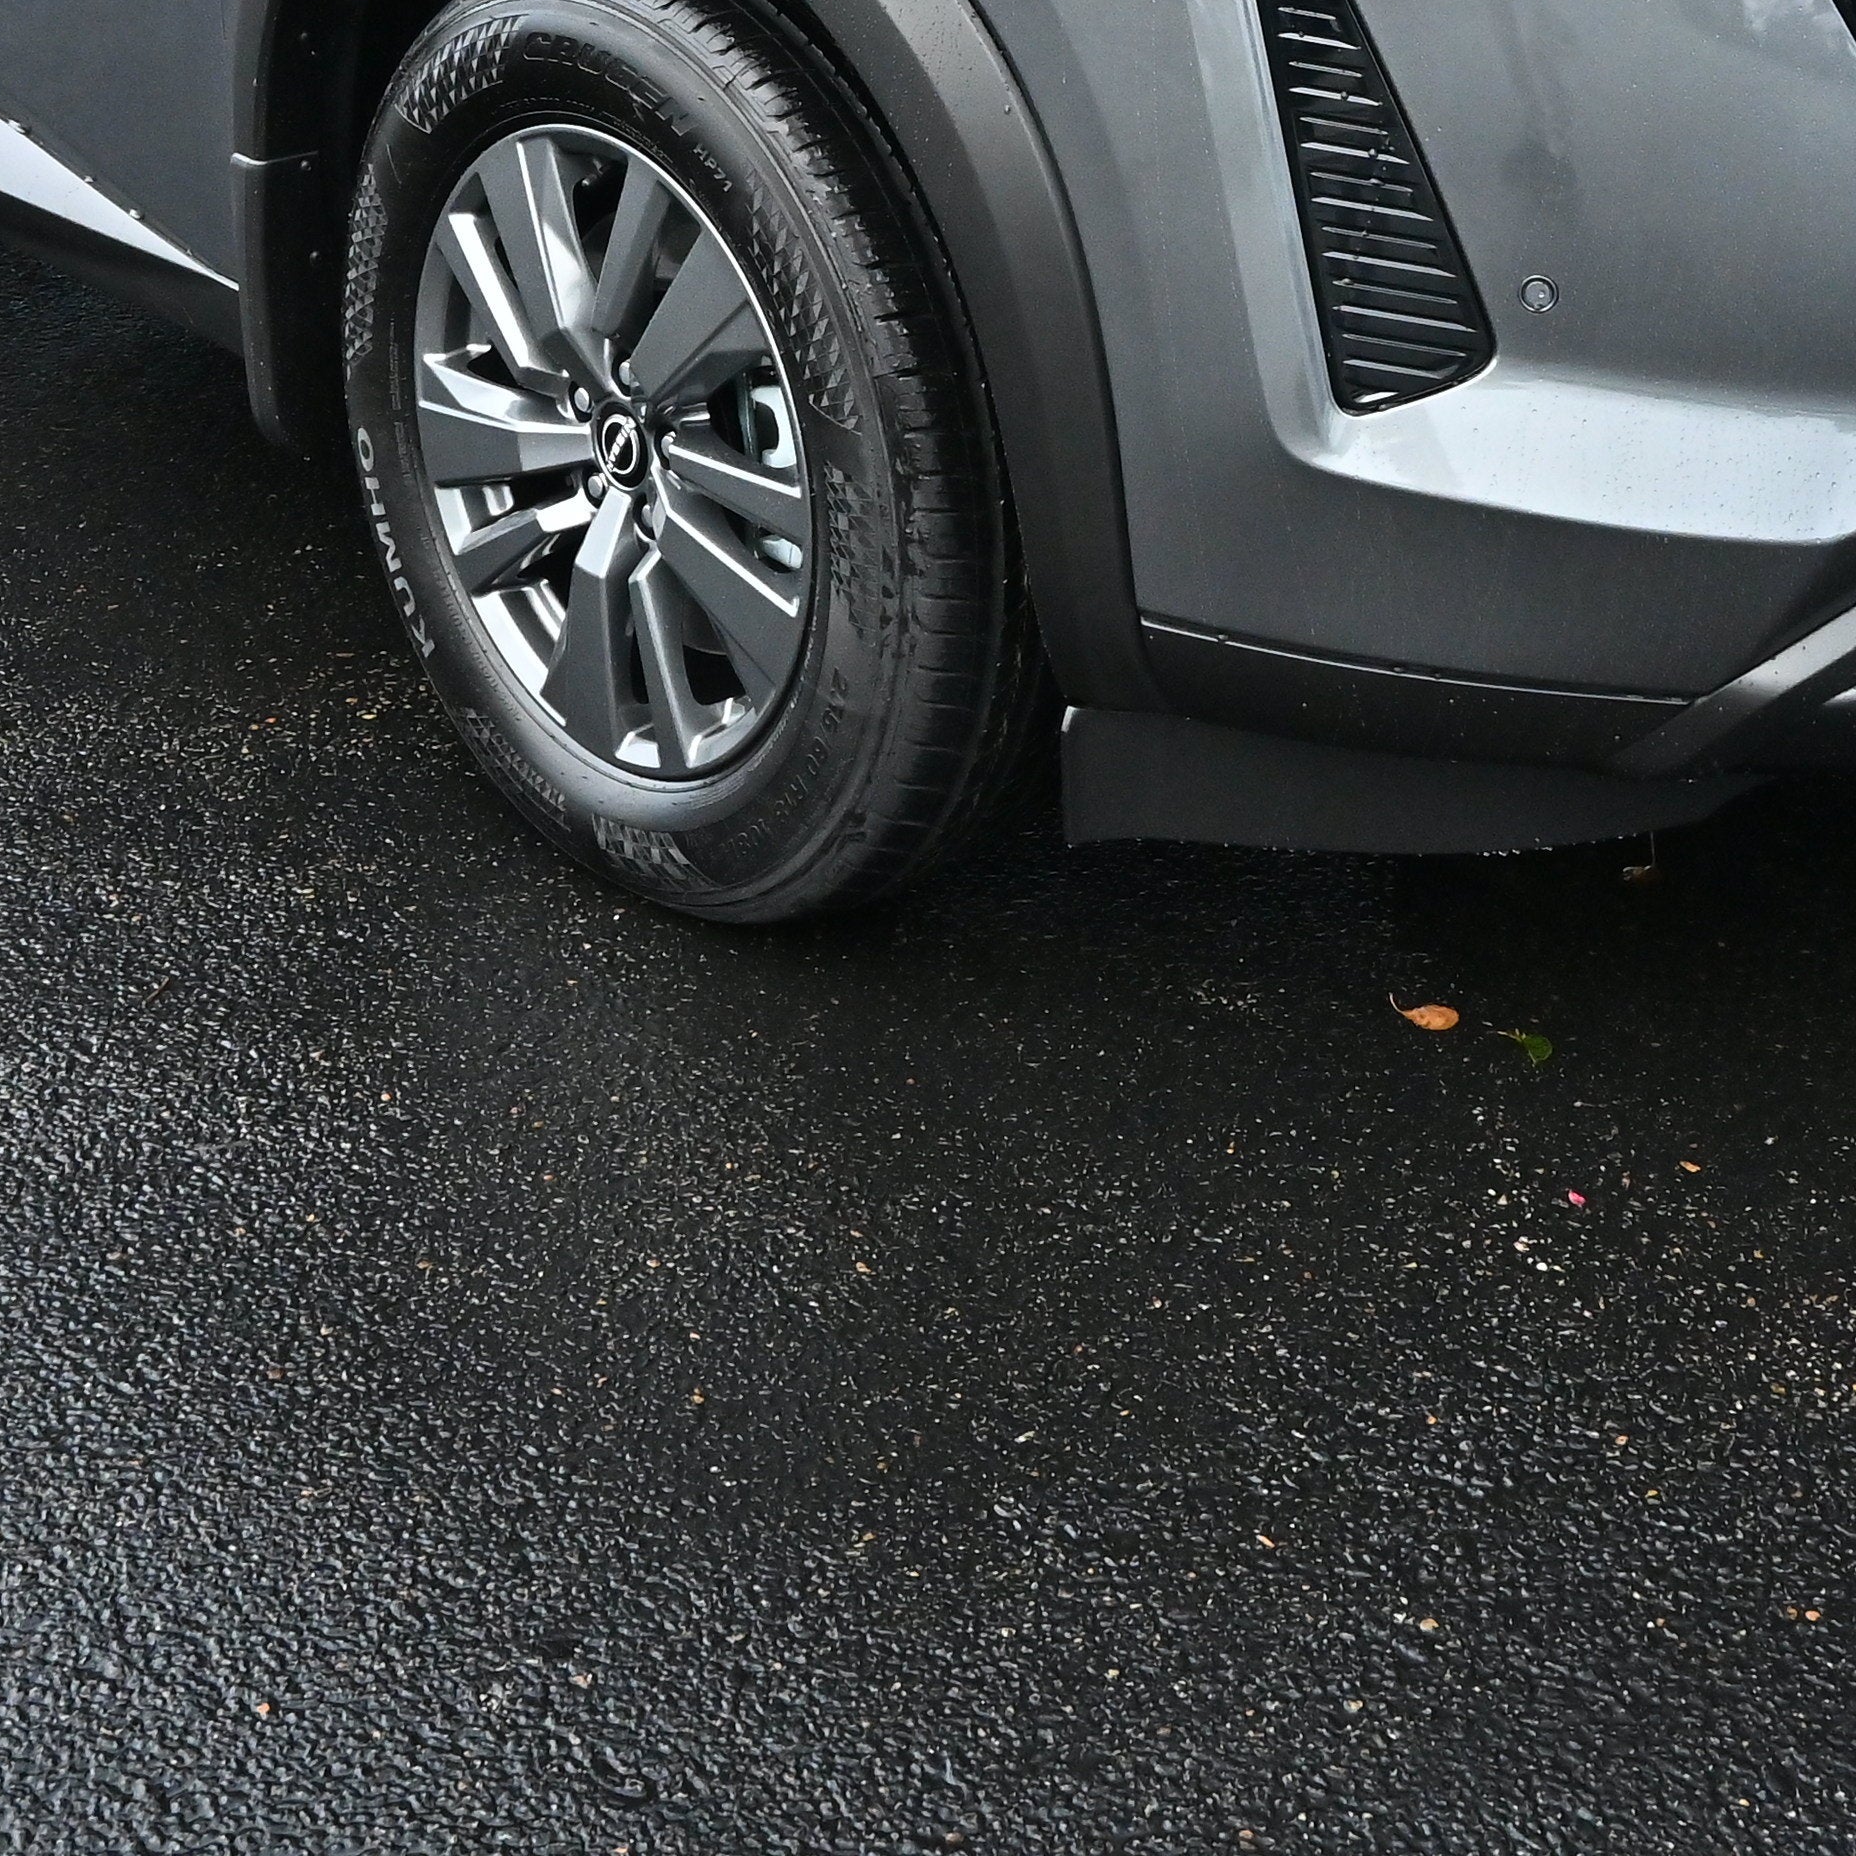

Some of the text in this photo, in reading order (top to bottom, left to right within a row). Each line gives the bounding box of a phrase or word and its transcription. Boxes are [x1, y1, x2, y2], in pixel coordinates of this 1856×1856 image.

[522, 31, 696, 137] CRUGEN
[692, 144, 733, 193] HP71
[357, 427, 436, 659] KUMHO
